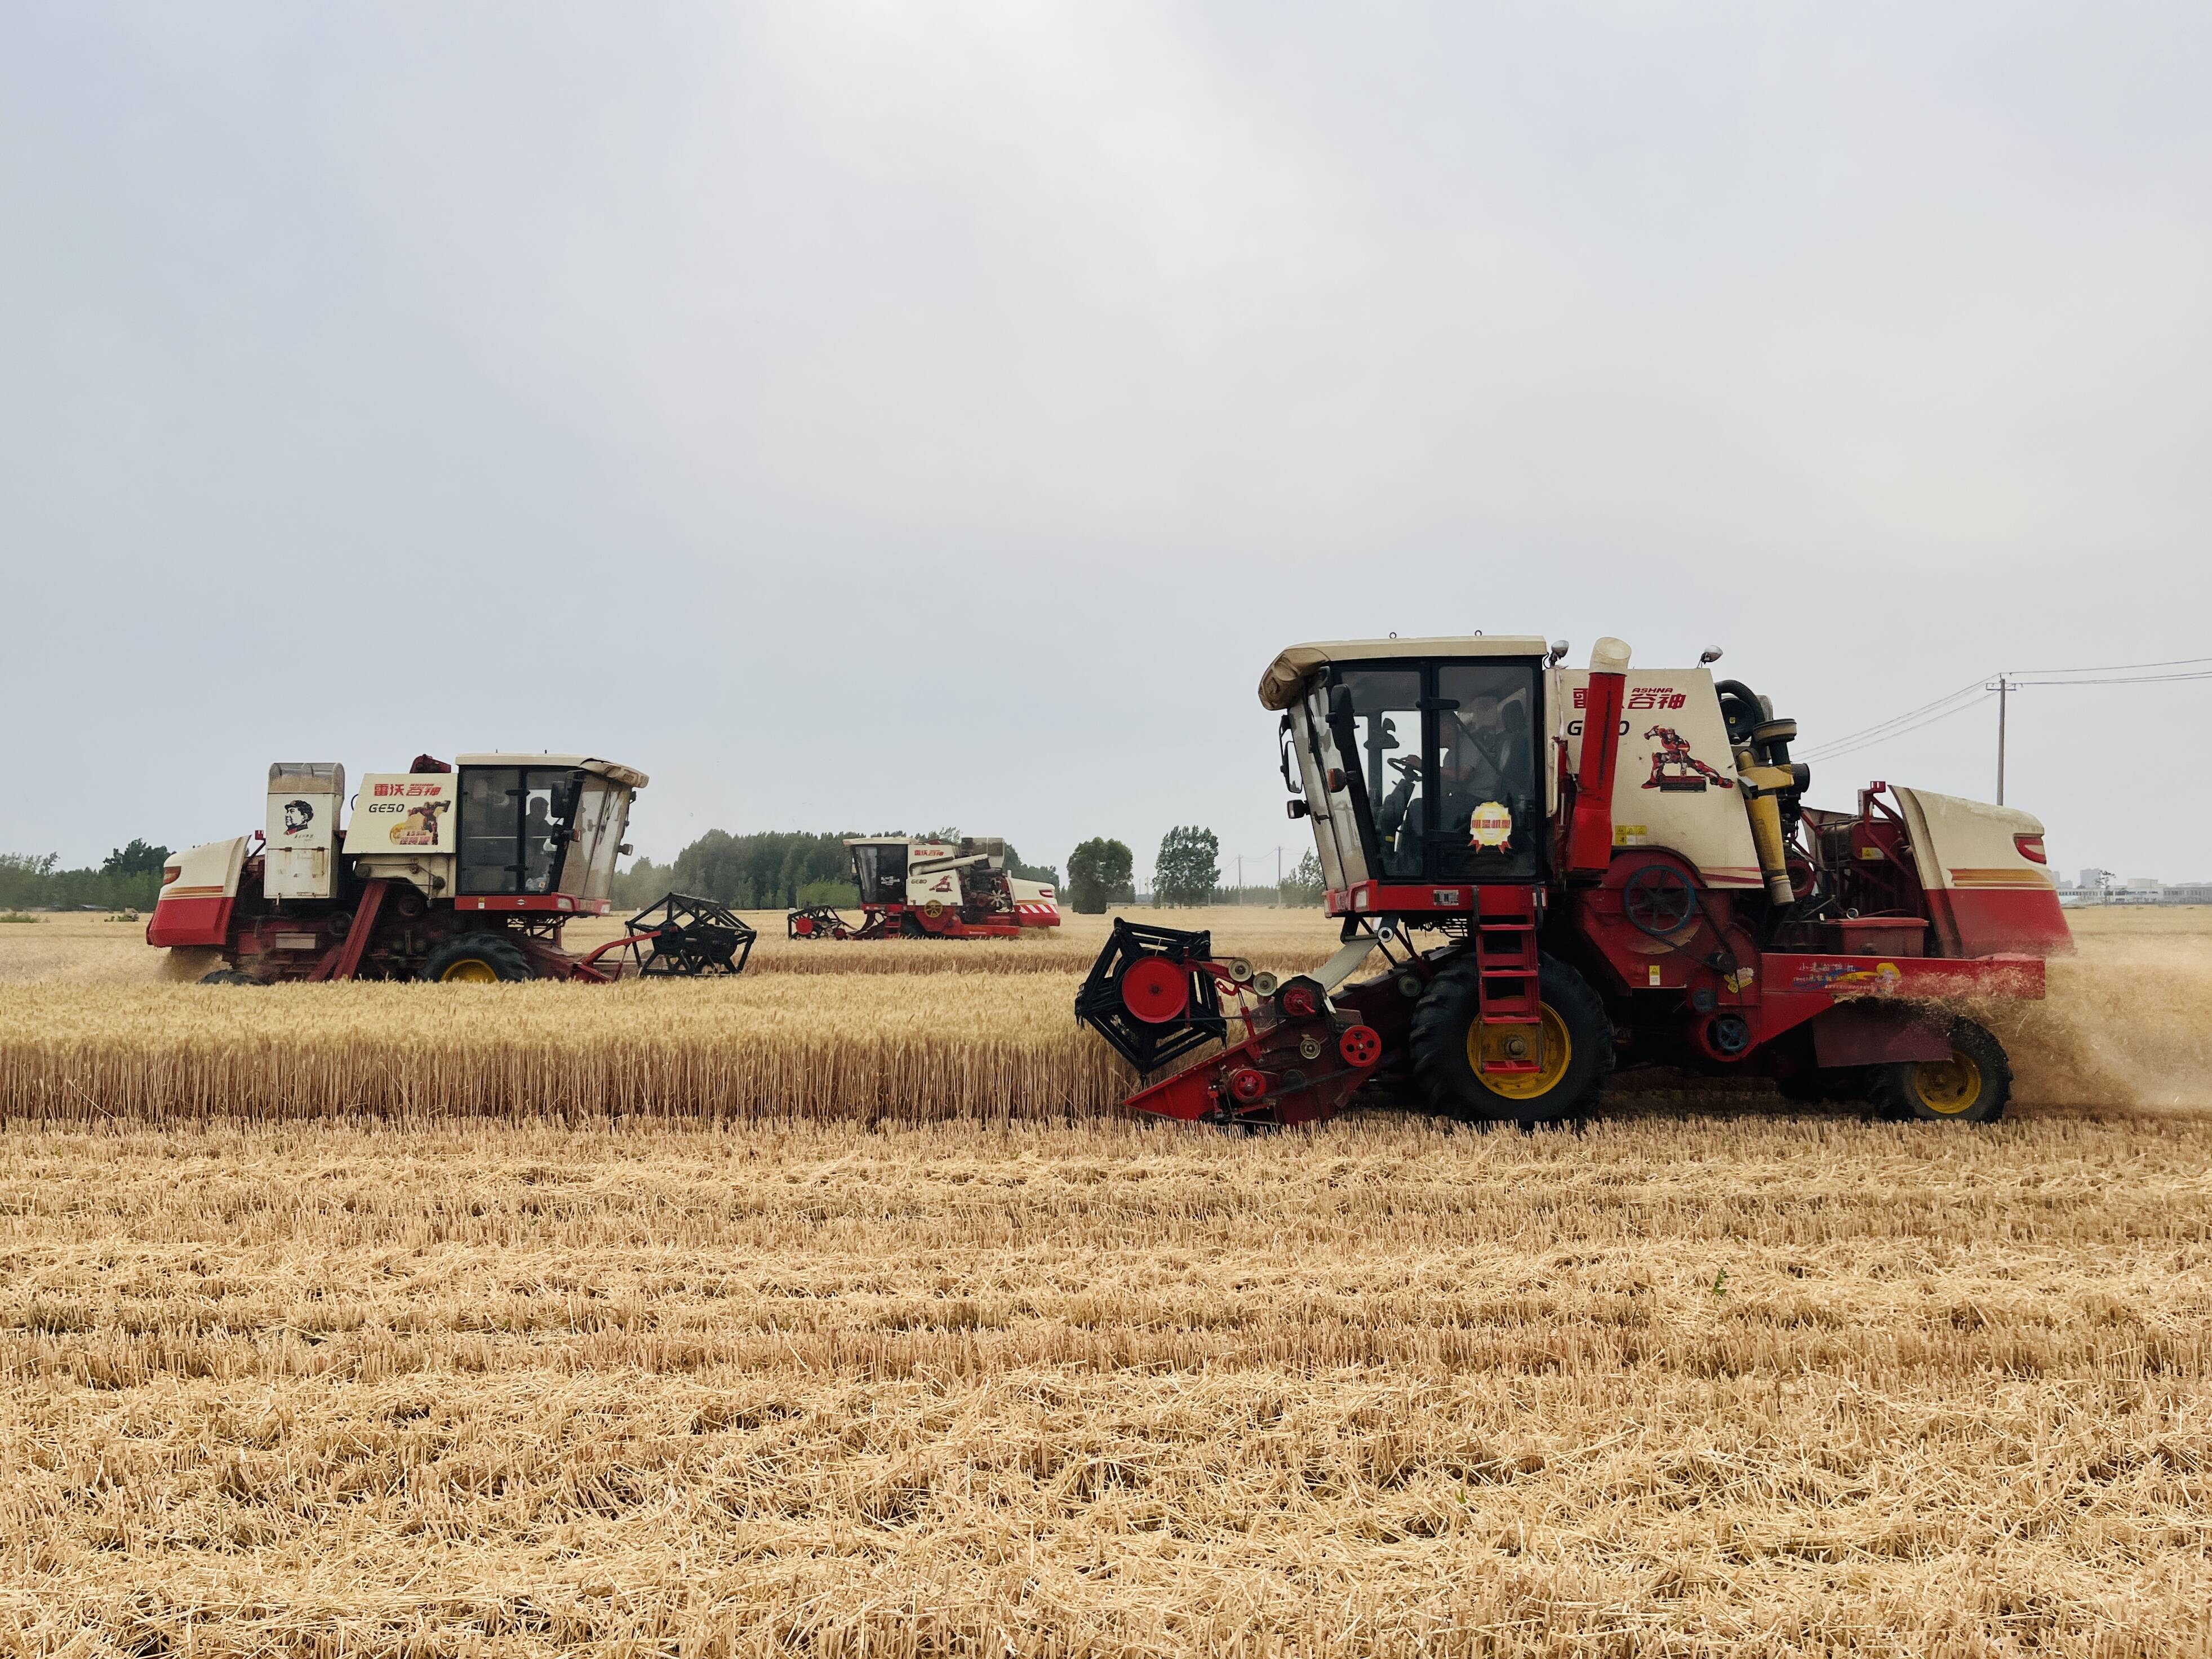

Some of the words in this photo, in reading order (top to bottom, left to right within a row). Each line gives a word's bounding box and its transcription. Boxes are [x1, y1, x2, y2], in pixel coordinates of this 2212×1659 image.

[1573, 688, 1686, 709] 雷谷神
[1567, 720, 1629, 735] G0
[374, 784, 442, 796] 雷沃谷神
[369, 804, 405, 813] GE50
